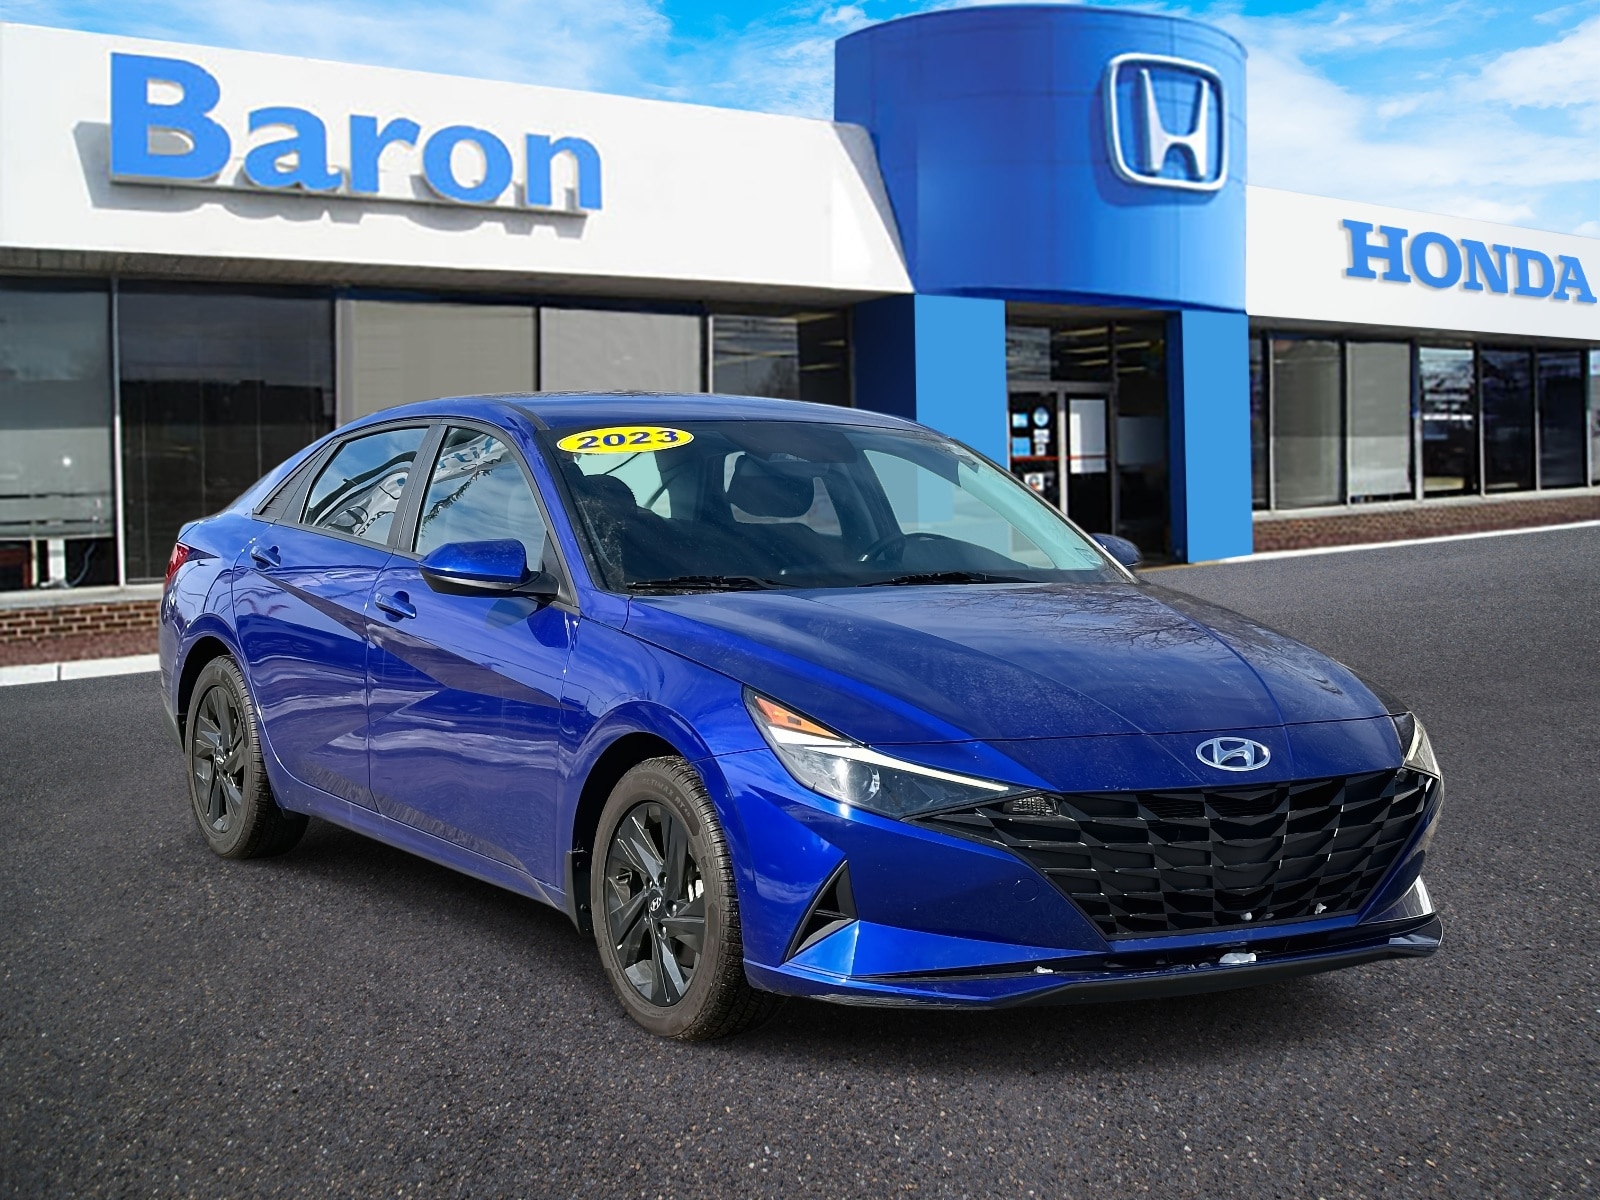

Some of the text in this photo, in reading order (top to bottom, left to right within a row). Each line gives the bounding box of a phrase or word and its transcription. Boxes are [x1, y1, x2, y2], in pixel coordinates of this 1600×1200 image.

[110, 52, 603, 211] Baron
[1342, 218, 1598, 304] HONDA
[576, 430, 680, 450] 2023
